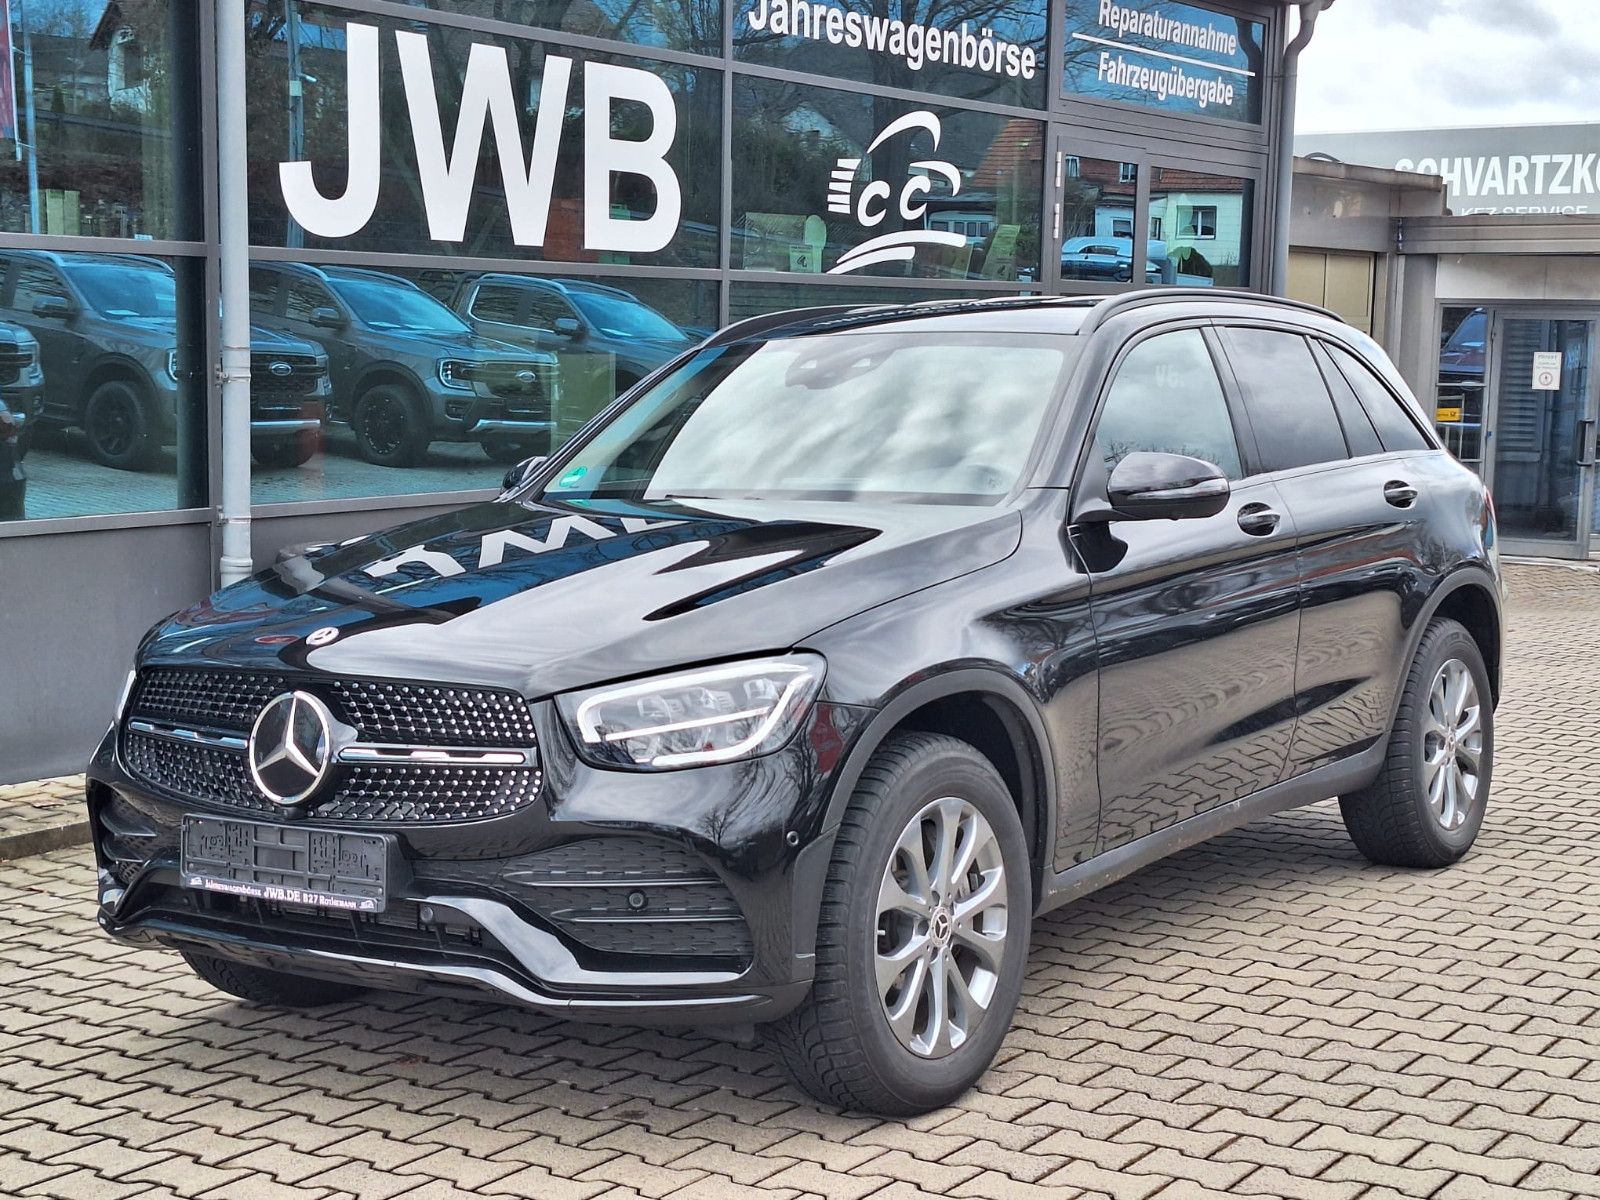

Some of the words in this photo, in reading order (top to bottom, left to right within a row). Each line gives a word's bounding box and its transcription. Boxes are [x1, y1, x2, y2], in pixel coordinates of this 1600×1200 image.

[748, 0, 1036, 79] Jahreswagenbörse
[1098, 0, 1237, 56] Reparaturannahme
[1098, 52, 1234, 108] Fahrzeugübergabe
[279, 22, 682, 253] JWB
[1394, 153, 1600, 197] HVARTZK
[263, 886, 301, 903] JWB.DE
